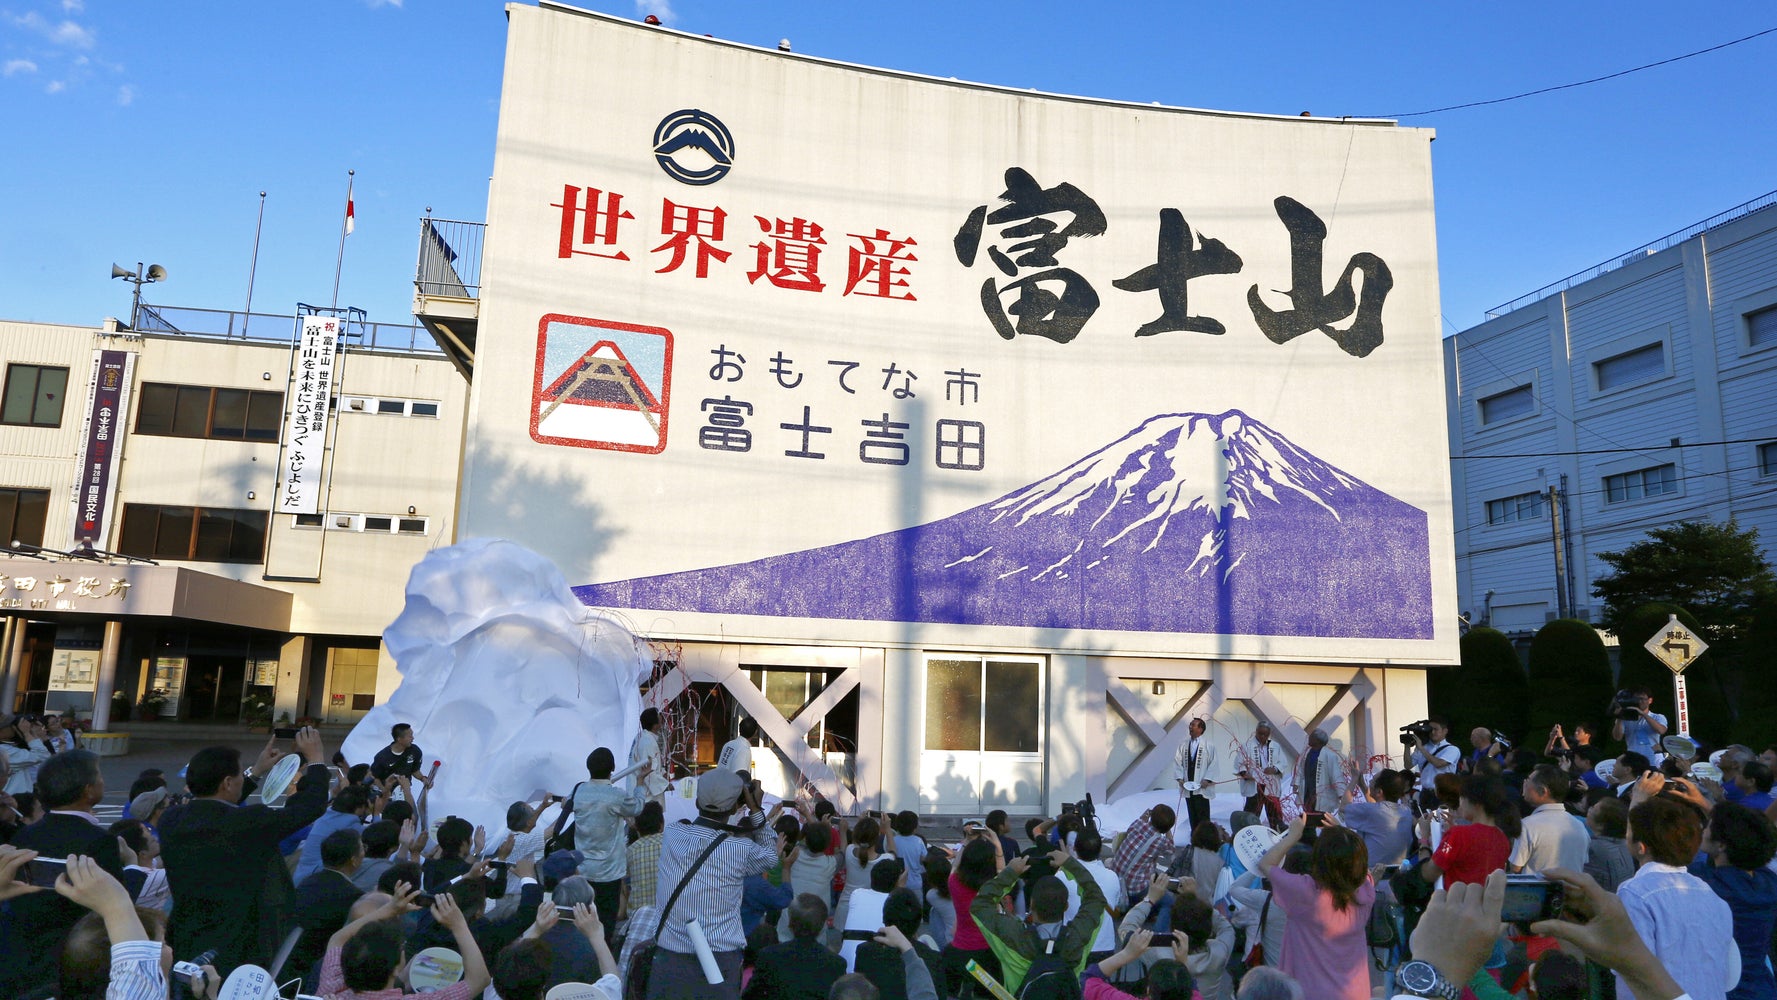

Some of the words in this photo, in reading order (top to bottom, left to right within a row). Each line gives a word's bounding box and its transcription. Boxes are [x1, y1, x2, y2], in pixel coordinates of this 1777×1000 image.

[550, 183, 918, 302] 世界遺産
[953, 166, 1394, 358] 富士山
[320, 336, 333, 366] 富士山
[324, 322, 335, 332] 祝
[294, 325, 321, 446] 富士山を未来にひきつぐ
[311, 370, 329, 432] 世界遺産登録
[709, 344, 981, 406] おもてな市
[699, 395, 985, 471] 富士吉田
[284, 450, 306, 507] ふじよしだ
